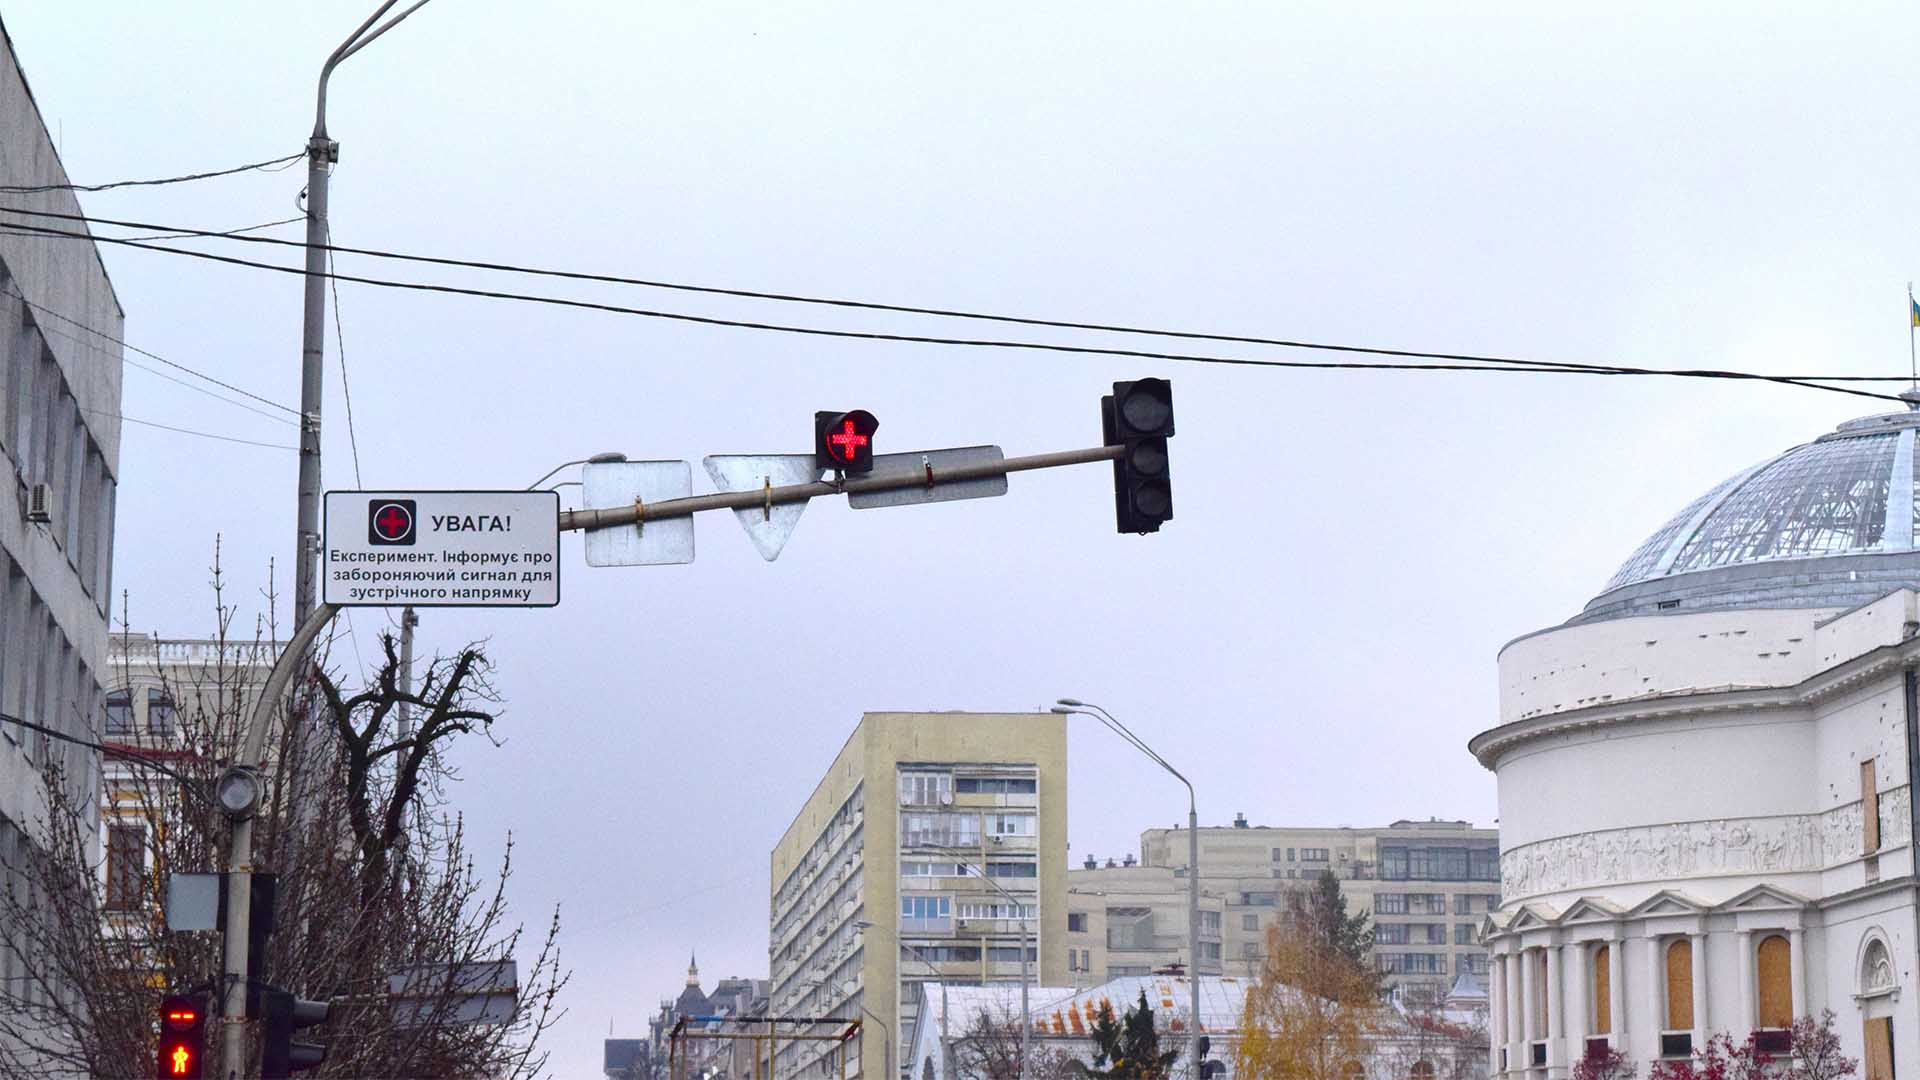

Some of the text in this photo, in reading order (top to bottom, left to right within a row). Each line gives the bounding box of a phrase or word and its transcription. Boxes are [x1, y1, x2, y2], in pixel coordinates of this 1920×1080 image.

[432, 515, 511, 531] УВАГА!
[331, 550, 552, 565] Експеримент. Інформує про
[333, 569, 552, 583] забороняючий сигнал для
[350, 586, 531, 601] зустрічного напрямку
